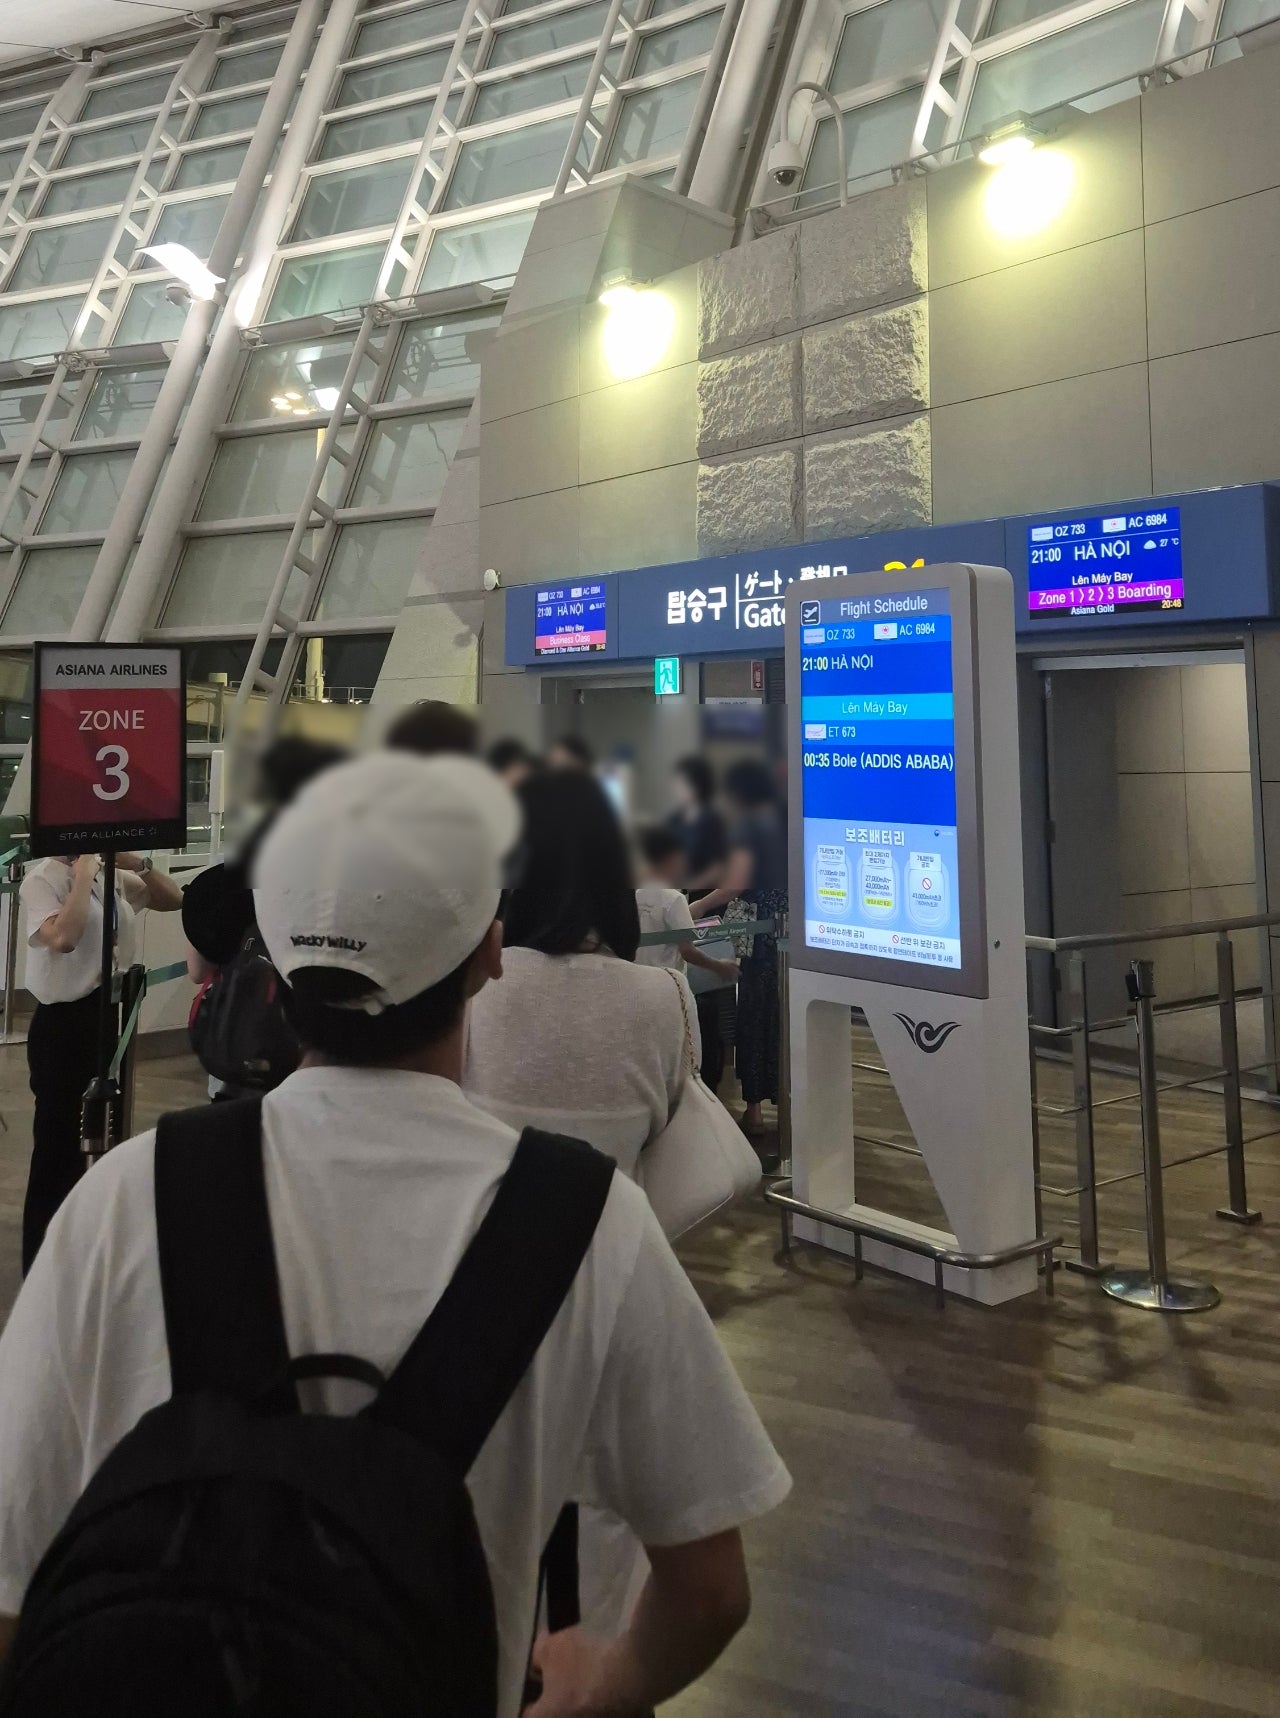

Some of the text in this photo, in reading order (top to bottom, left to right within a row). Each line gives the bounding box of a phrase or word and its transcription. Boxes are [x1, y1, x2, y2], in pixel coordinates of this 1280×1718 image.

[1055, 527, 1068, 537] OZ
[1071, 524, 1086, 535] 733
[1128, 517, 1143, 528] AC
[1146, 513, 1167, 525] 6984
[1031, 548, 1061, 563] 21:00
[1074, 542, 1097, 561] HÀ
[1101, 540, 1130, 559] NỘI
[1072, 571, 1133, 586] Lên Máy Bay
[1039, 584, 1171, 605] Zone 1 2 3 Boarding
[668, 586, 727, 624] 탑승구
[840, 597, 928, 618] Flight Schedule
[1071, 606, 1095, 615] Asiana
[1097, 604, 1114, 613] Gold
[827, 630, 839, 640] OZ
[842, 628, 855, 639] 733
[900, 624, 913, 636] AC
[915, 622, 935, 634] 6984
[56, 664, 167, 676] ASIANA AIRLINES
[802, 654, 874, 671] 21:00 HÀ NỘI
[842, 700, 908, 716] Lên Máy Bay
[78, 709, 145, 731] ZONE
[828, 726, 856, 738] ET 673
[804, 752, 953, 772] 00:35 Bole (ADDIS ABABA)
[92, 744, 130, 801] 3
[60, 828, 145, 840] STAR ALLIANCE
[845, 827, 905, 847] 보조배터리
